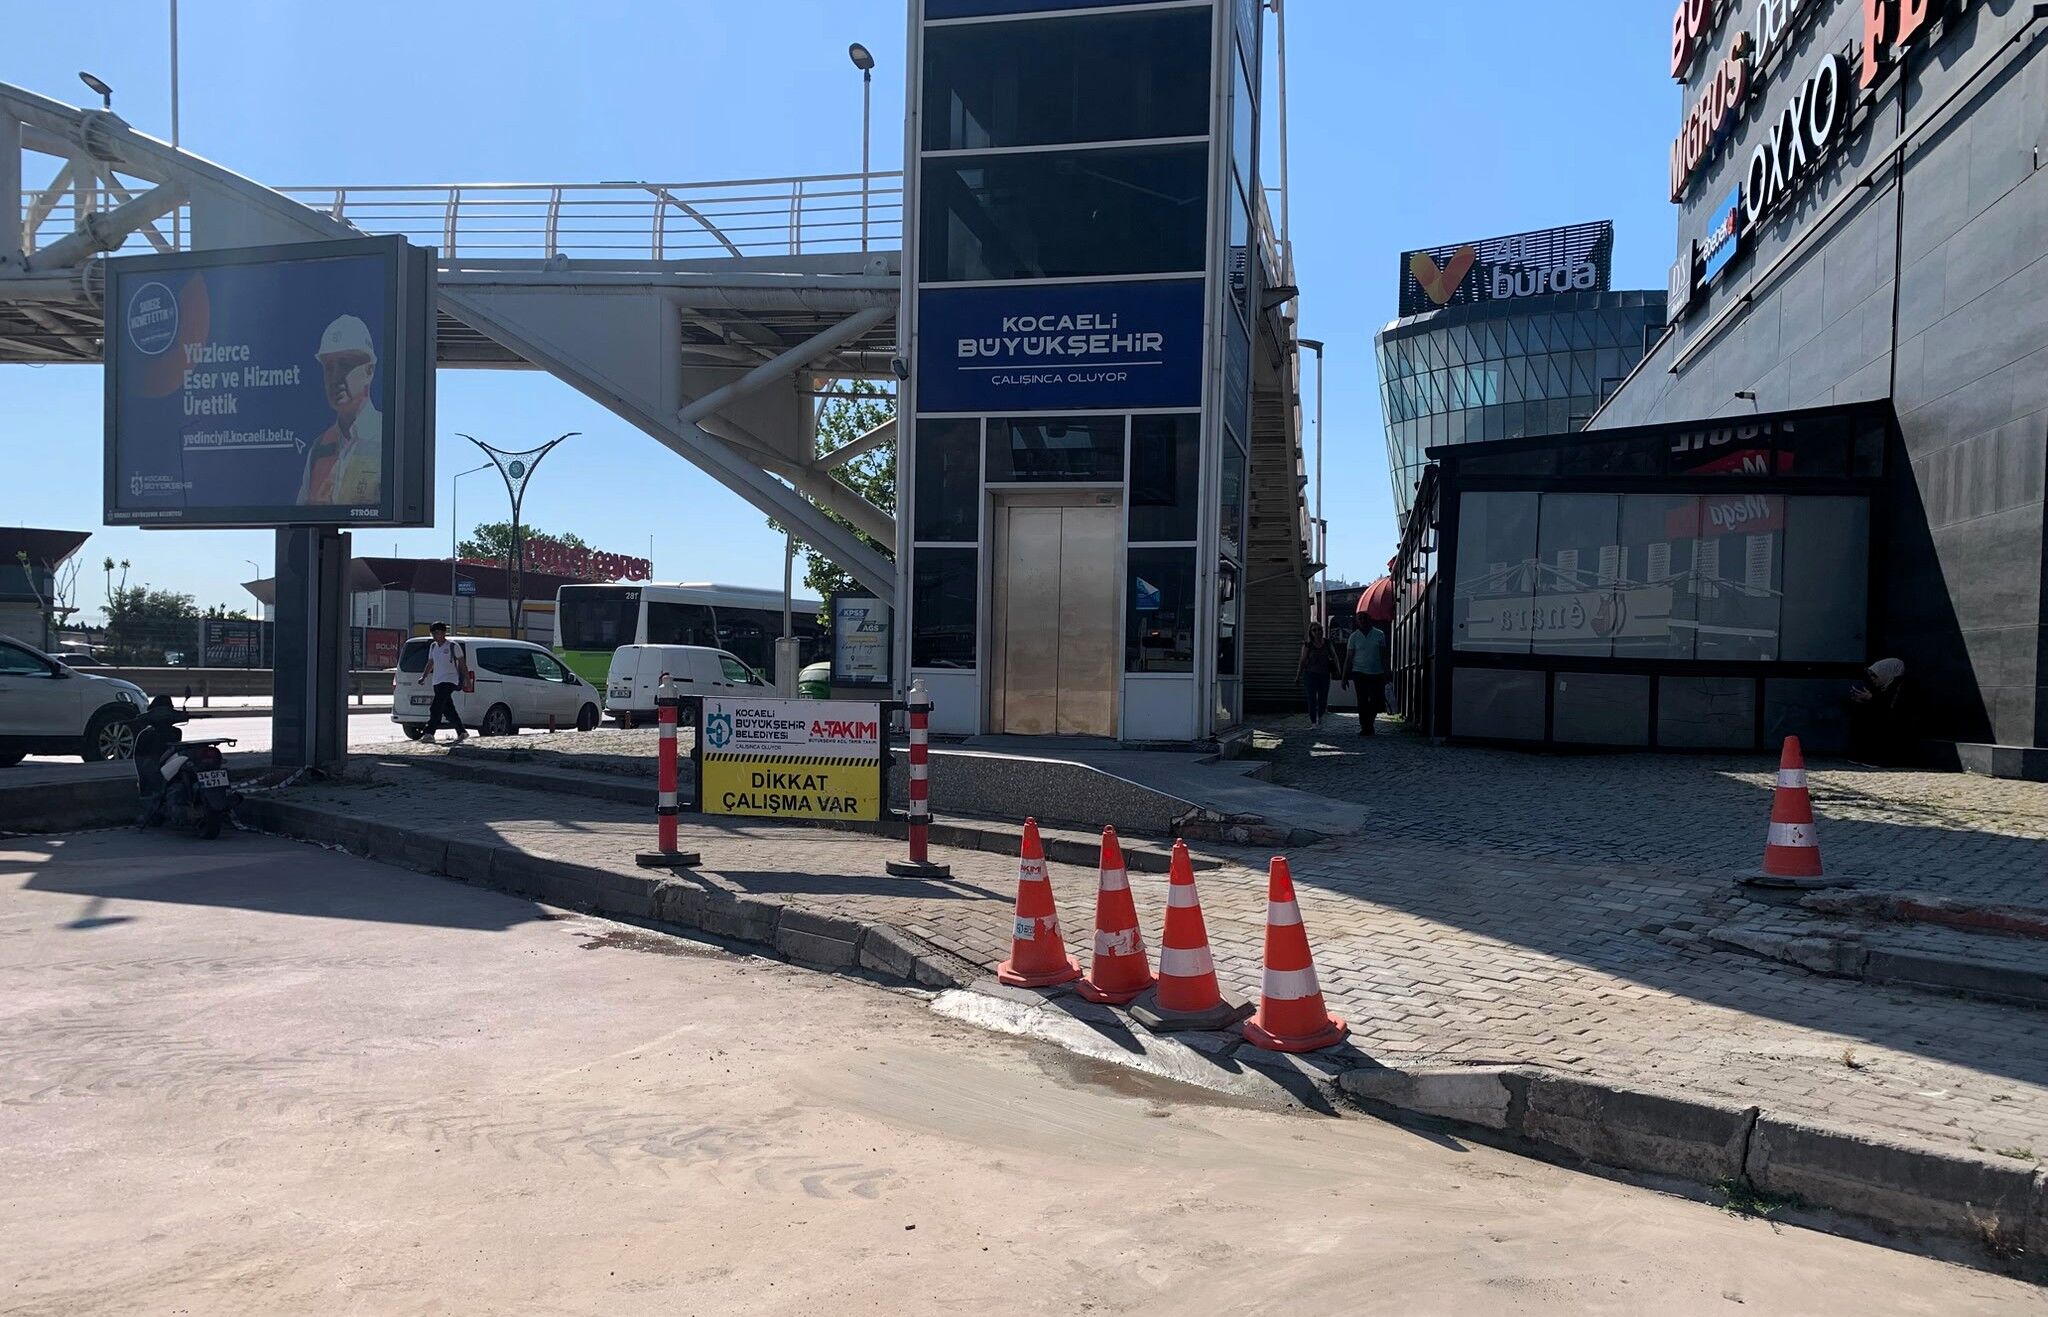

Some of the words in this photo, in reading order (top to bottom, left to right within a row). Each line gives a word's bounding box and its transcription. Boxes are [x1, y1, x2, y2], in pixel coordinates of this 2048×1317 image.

[1746, 53, 1838, 222] OXXO
[1492, 255, 1597, 299] burda
[1002, 313, 1117, 332] KOCAELİ
[183, 342, 250, 364] Yüzlerce
[957, 332, 1163, 357] BÜYÜKŞEHİR
[183, 369, 218, 389] Eser
[222, 371, 239, 388] ve
[243, 364, 301, 387] Hizmet
[991, 373, 1063, 386] ÇALIŞINCA
[1067, 372, 1128, 383] OLUYOR
[183, 391, 237, 416] Ürettik
[735, 709, 775, 718] KOCAELİ
[735, 719, 806, 731] BÜYÜKŞEHİR
[735, 730, 789, 740] BELEDİYESİ
[810, 720, 877, 739] A-TAKIMI
[751, 769, 829, 791] DİKKAT
[722, 792, 812, 813] ÇALIŞMA
[818, 796, 858, 813] VAR
